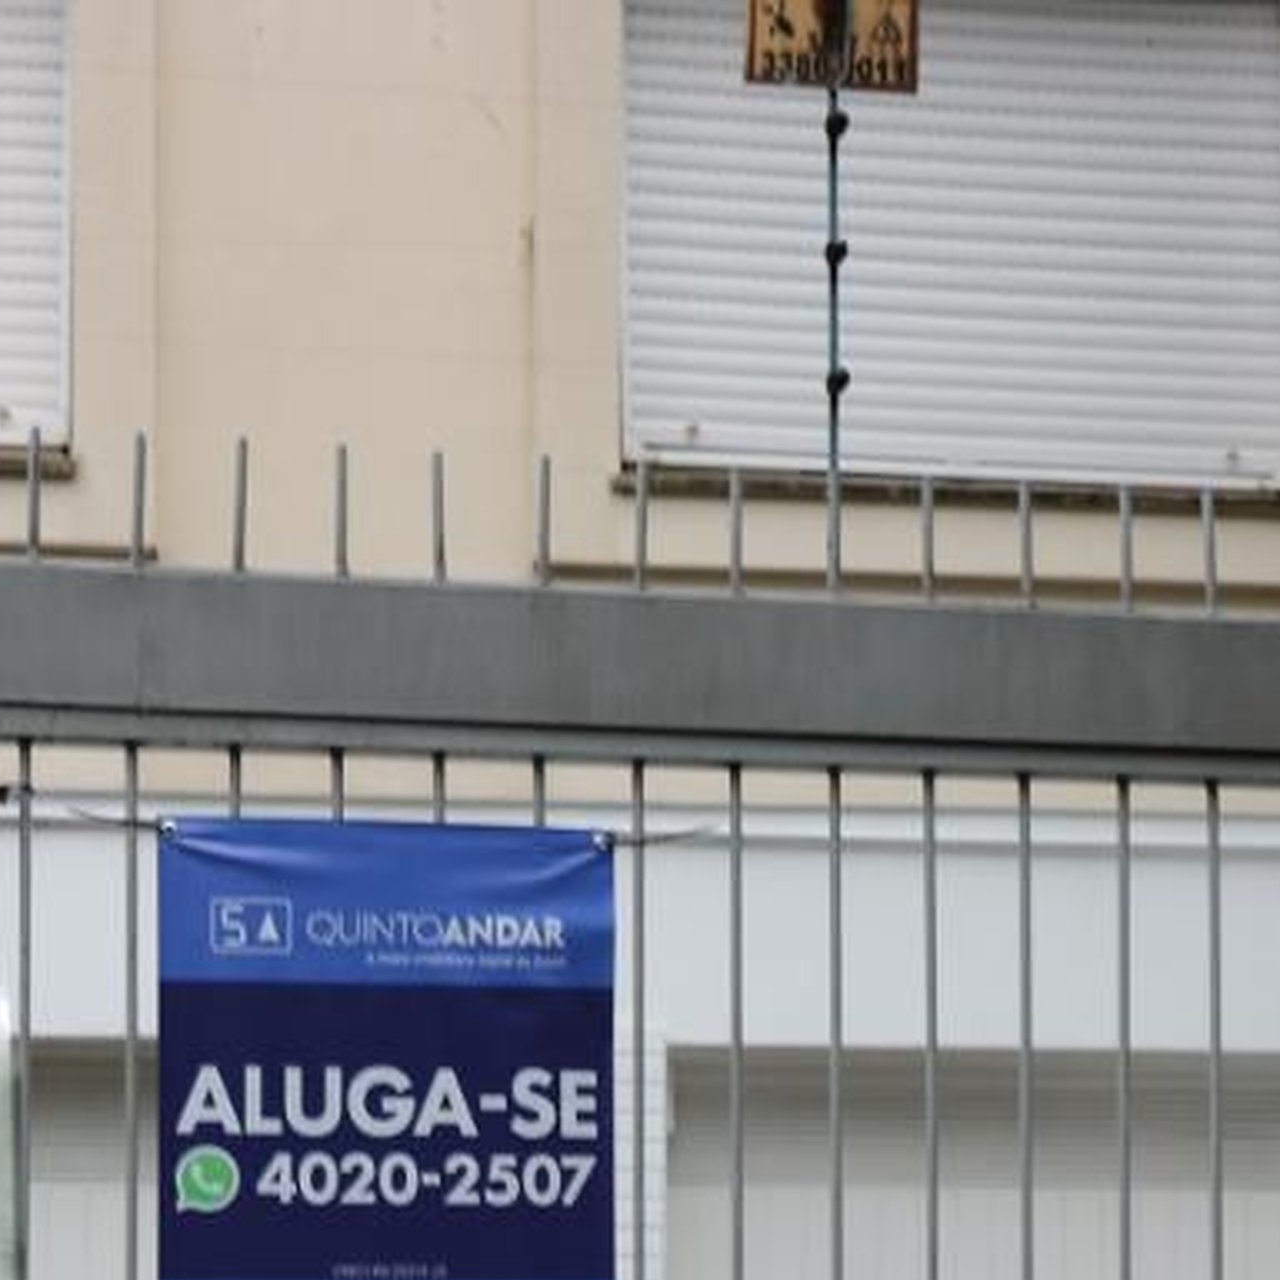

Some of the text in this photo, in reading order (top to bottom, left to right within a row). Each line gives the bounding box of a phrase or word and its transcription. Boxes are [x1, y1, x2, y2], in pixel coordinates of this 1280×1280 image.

[306, 909, 565, 950] QUINTOANDAR
[175, 1064, 599, 1139] ALUGA-SE
[256, 1151, 597, 1207] 4020-2507
